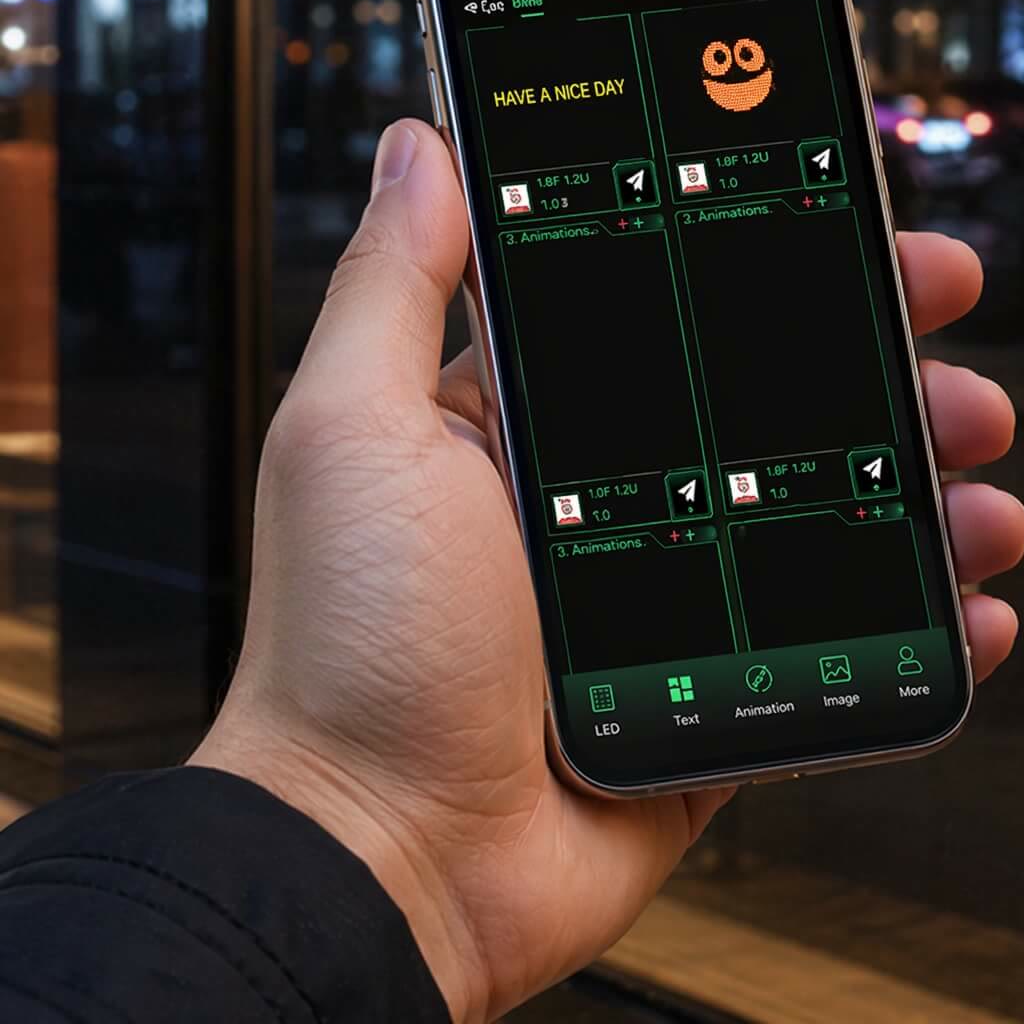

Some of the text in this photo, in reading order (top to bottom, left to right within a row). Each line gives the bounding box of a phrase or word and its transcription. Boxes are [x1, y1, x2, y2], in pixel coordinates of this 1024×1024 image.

[493, 78, 625, 107] HAVE A NICE DAY
[898, 685, 930, 698] More
[823, 693, 861, 708] Image
[734, 701, 795, 719] Animation
[672, 713, 701, 727] Text
[594, 722, 621, 737] LED
